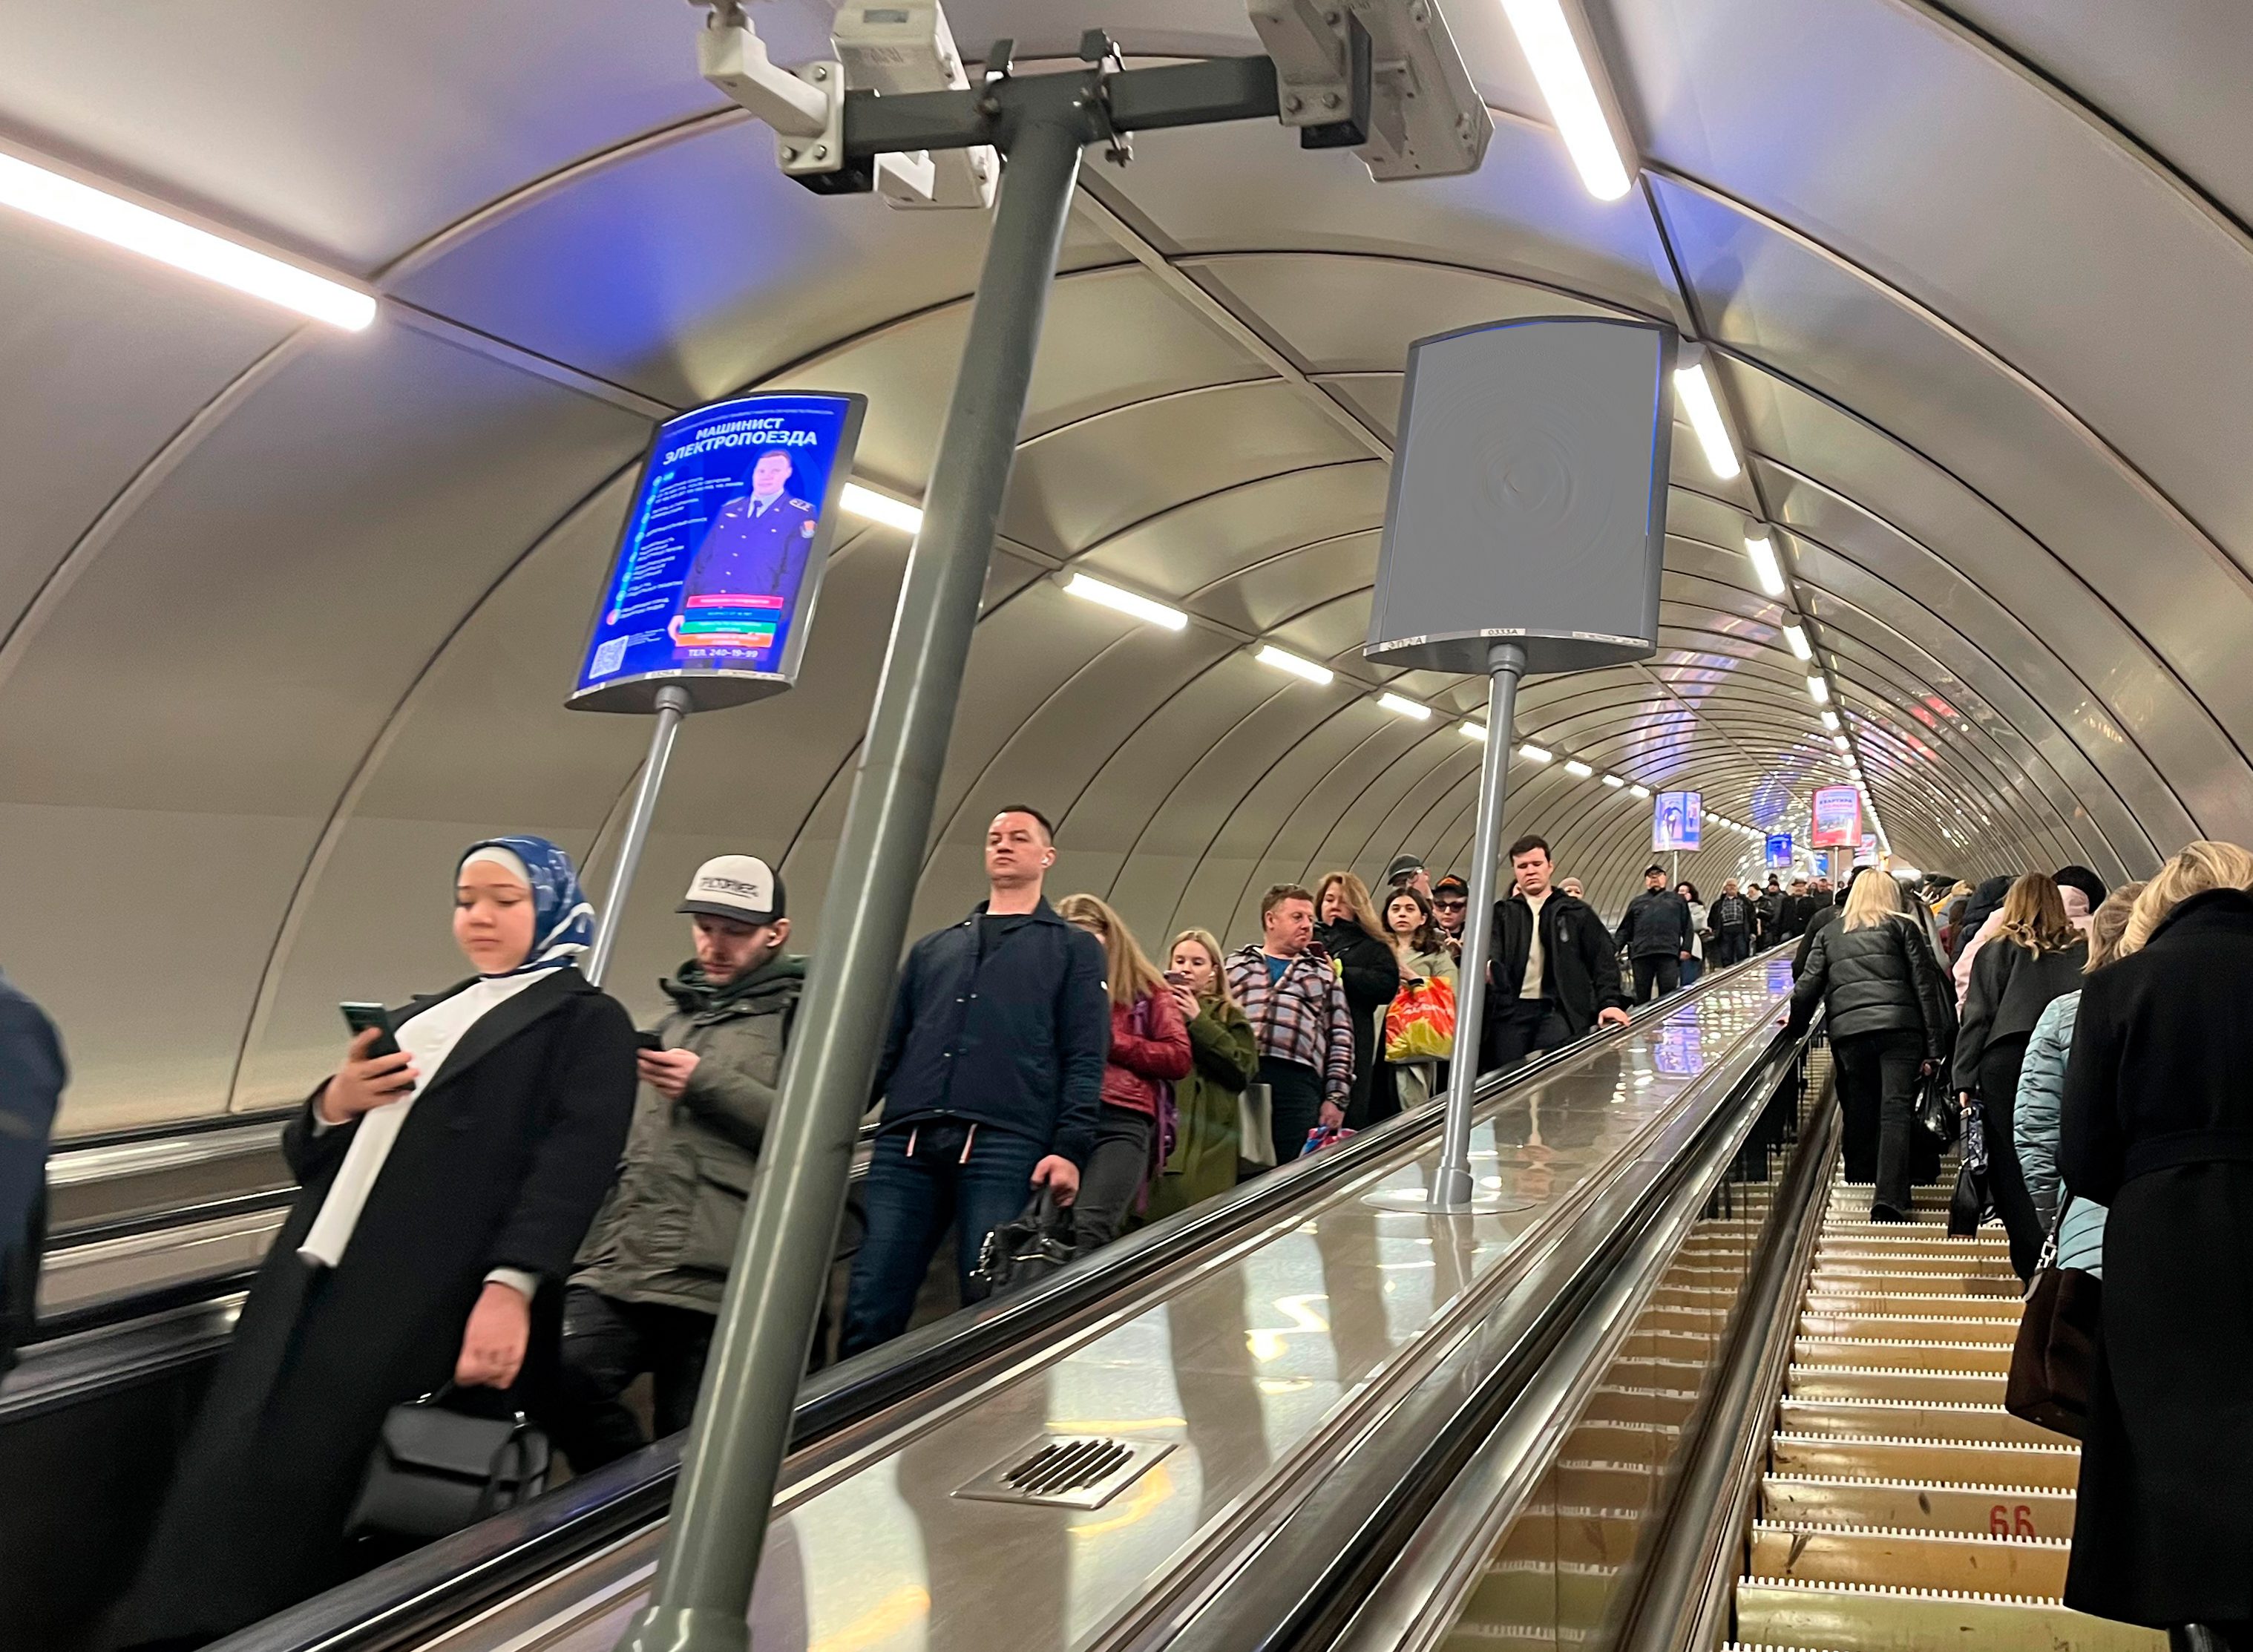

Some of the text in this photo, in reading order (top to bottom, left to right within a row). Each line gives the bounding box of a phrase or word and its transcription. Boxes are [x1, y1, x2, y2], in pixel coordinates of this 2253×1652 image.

[695, 418, 785, 440] МАШИНИСТ
[663, 430, 818, 465] ЭЛЕКТРОПОЕЗДА
[1990, 1505, 2036, 1542] 66
